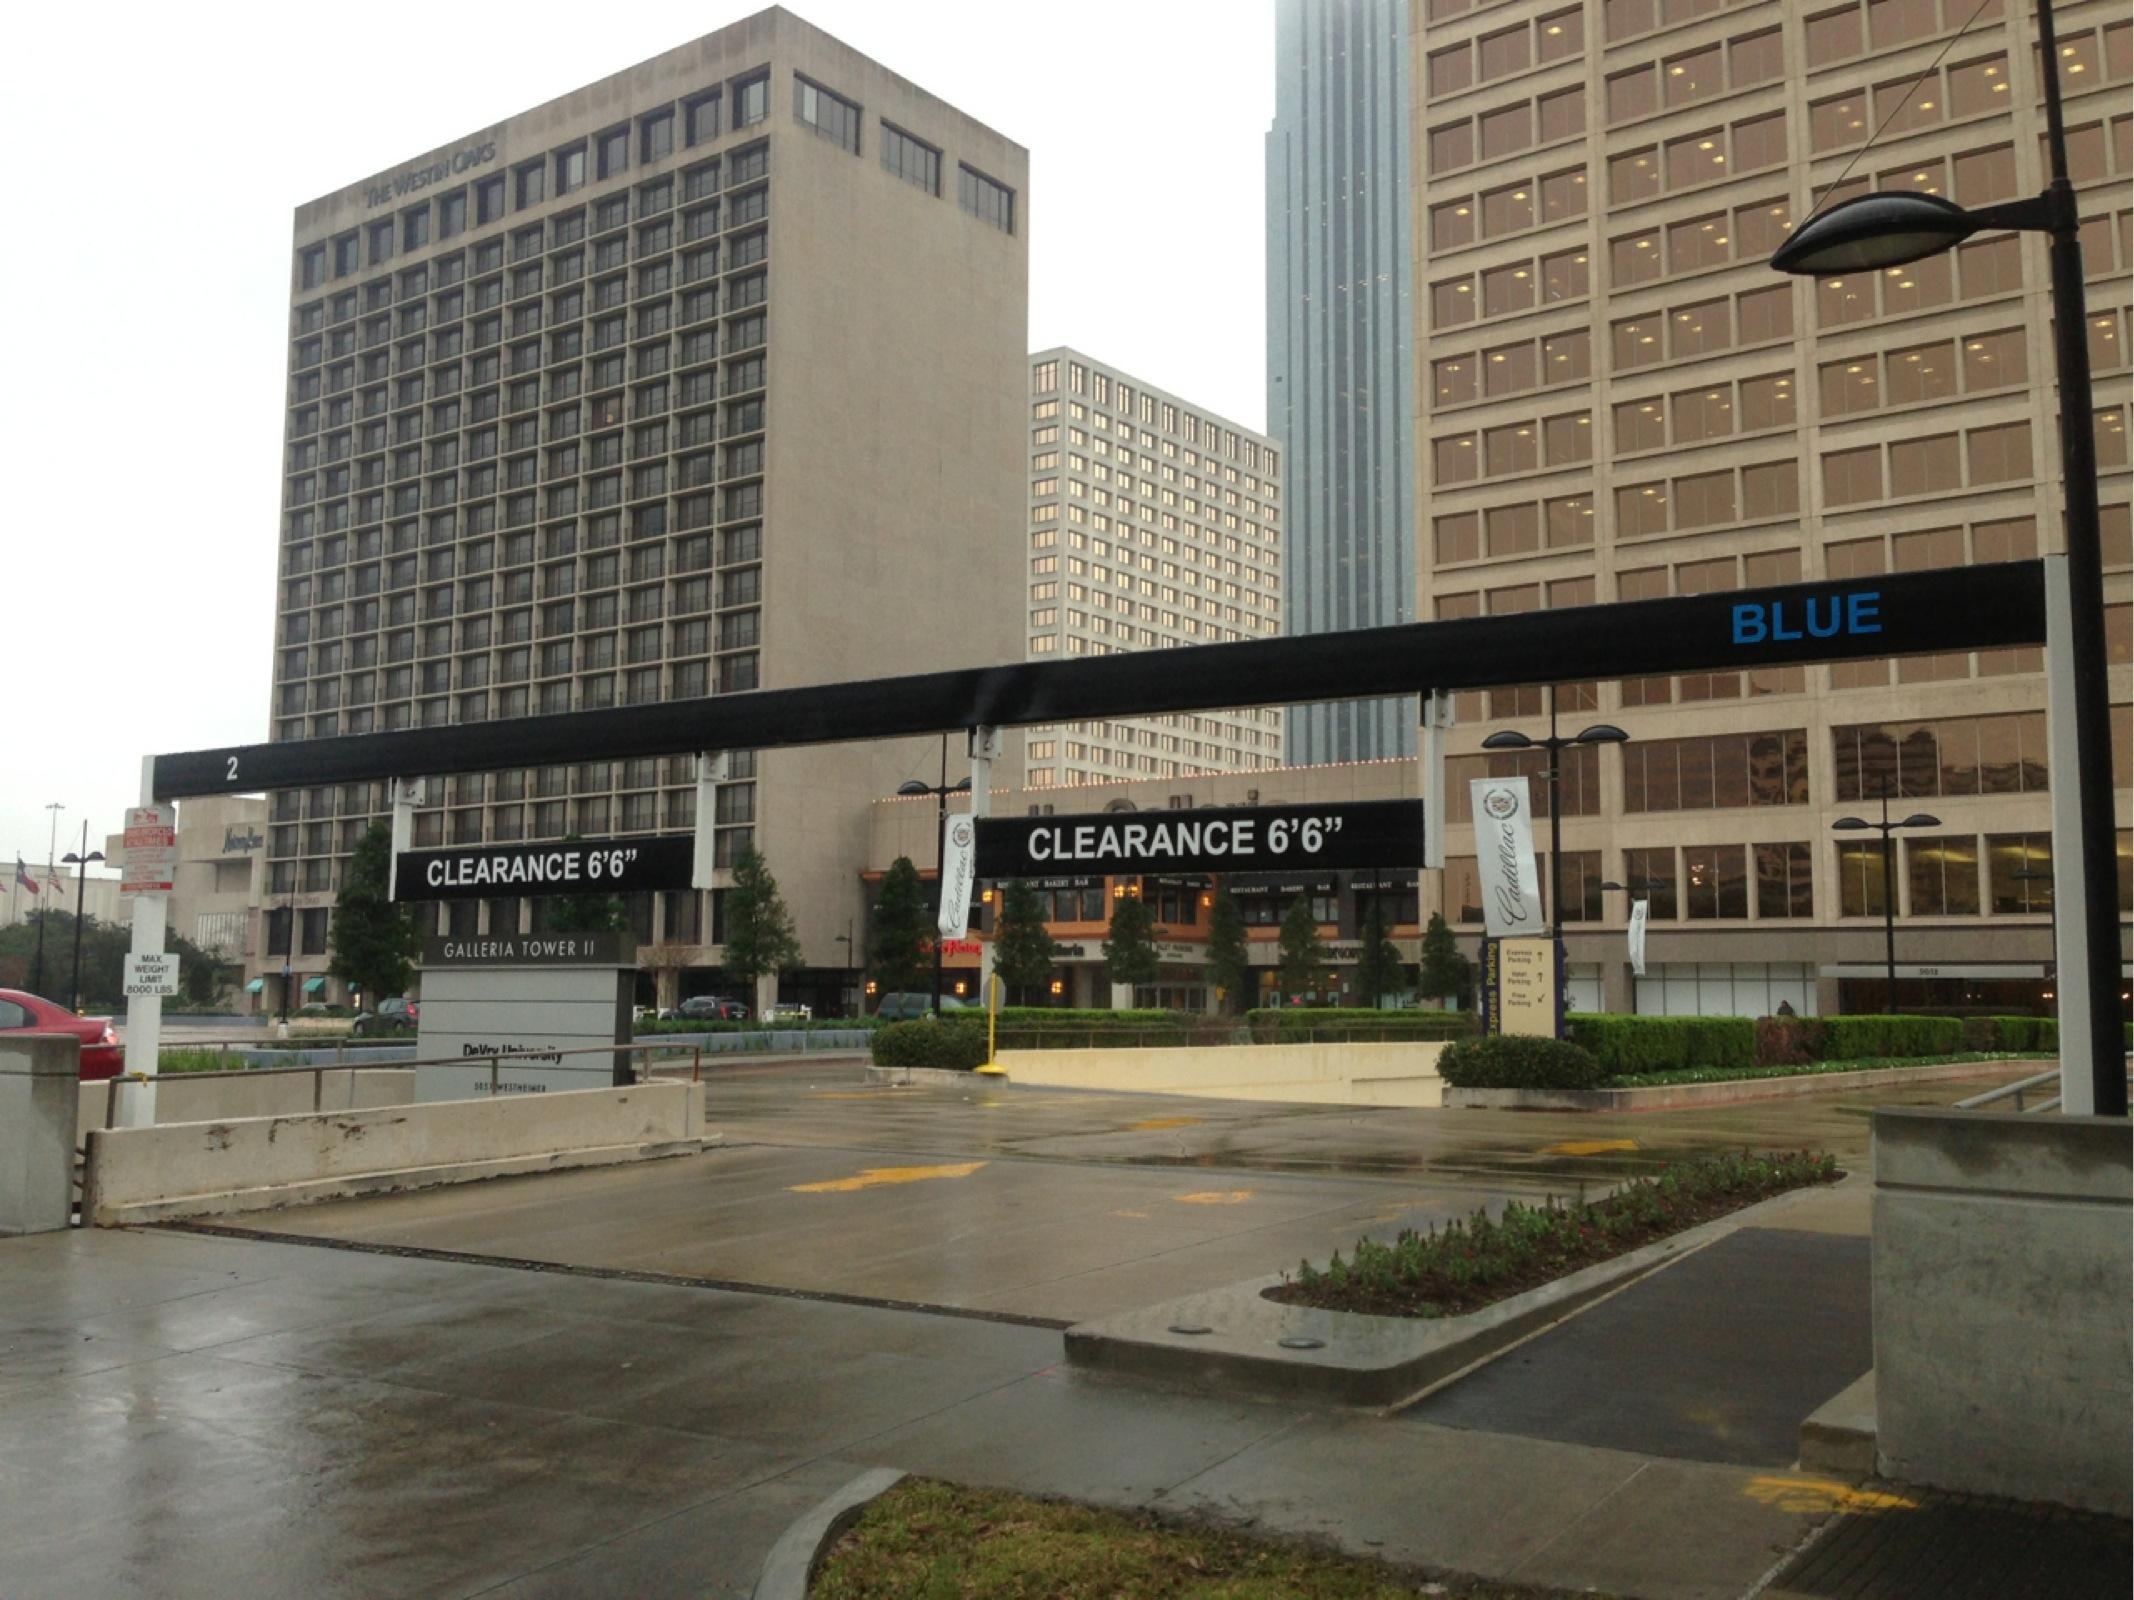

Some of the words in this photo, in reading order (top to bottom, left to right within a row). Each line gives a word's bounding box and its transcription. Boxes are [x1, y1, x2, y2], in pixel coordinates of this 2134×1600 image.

[1732, 591, 1883, 645] BLUE
[226, 755, 239, 781] 2
[1027, 819, 1255, 861] CLEARANCE
[427, 852, 581, 888] CLEARANCE
[1494, 822, 1528, 926] Cadillac
[443, 942, 515, 958] GALLERIA
[522, 940, 577, 957] TOWER
[584, 940, 595, 956] II
[1487, 943, 1497, 986] Parking
[134, 964, 169, 974] WEIGHT
[139, 974, 163, 984] LIMIT
[126, 984, 153, 994] 8000
[155, 984, 173, 994] LBS
[1487, 990, 1498, 1038] Express
